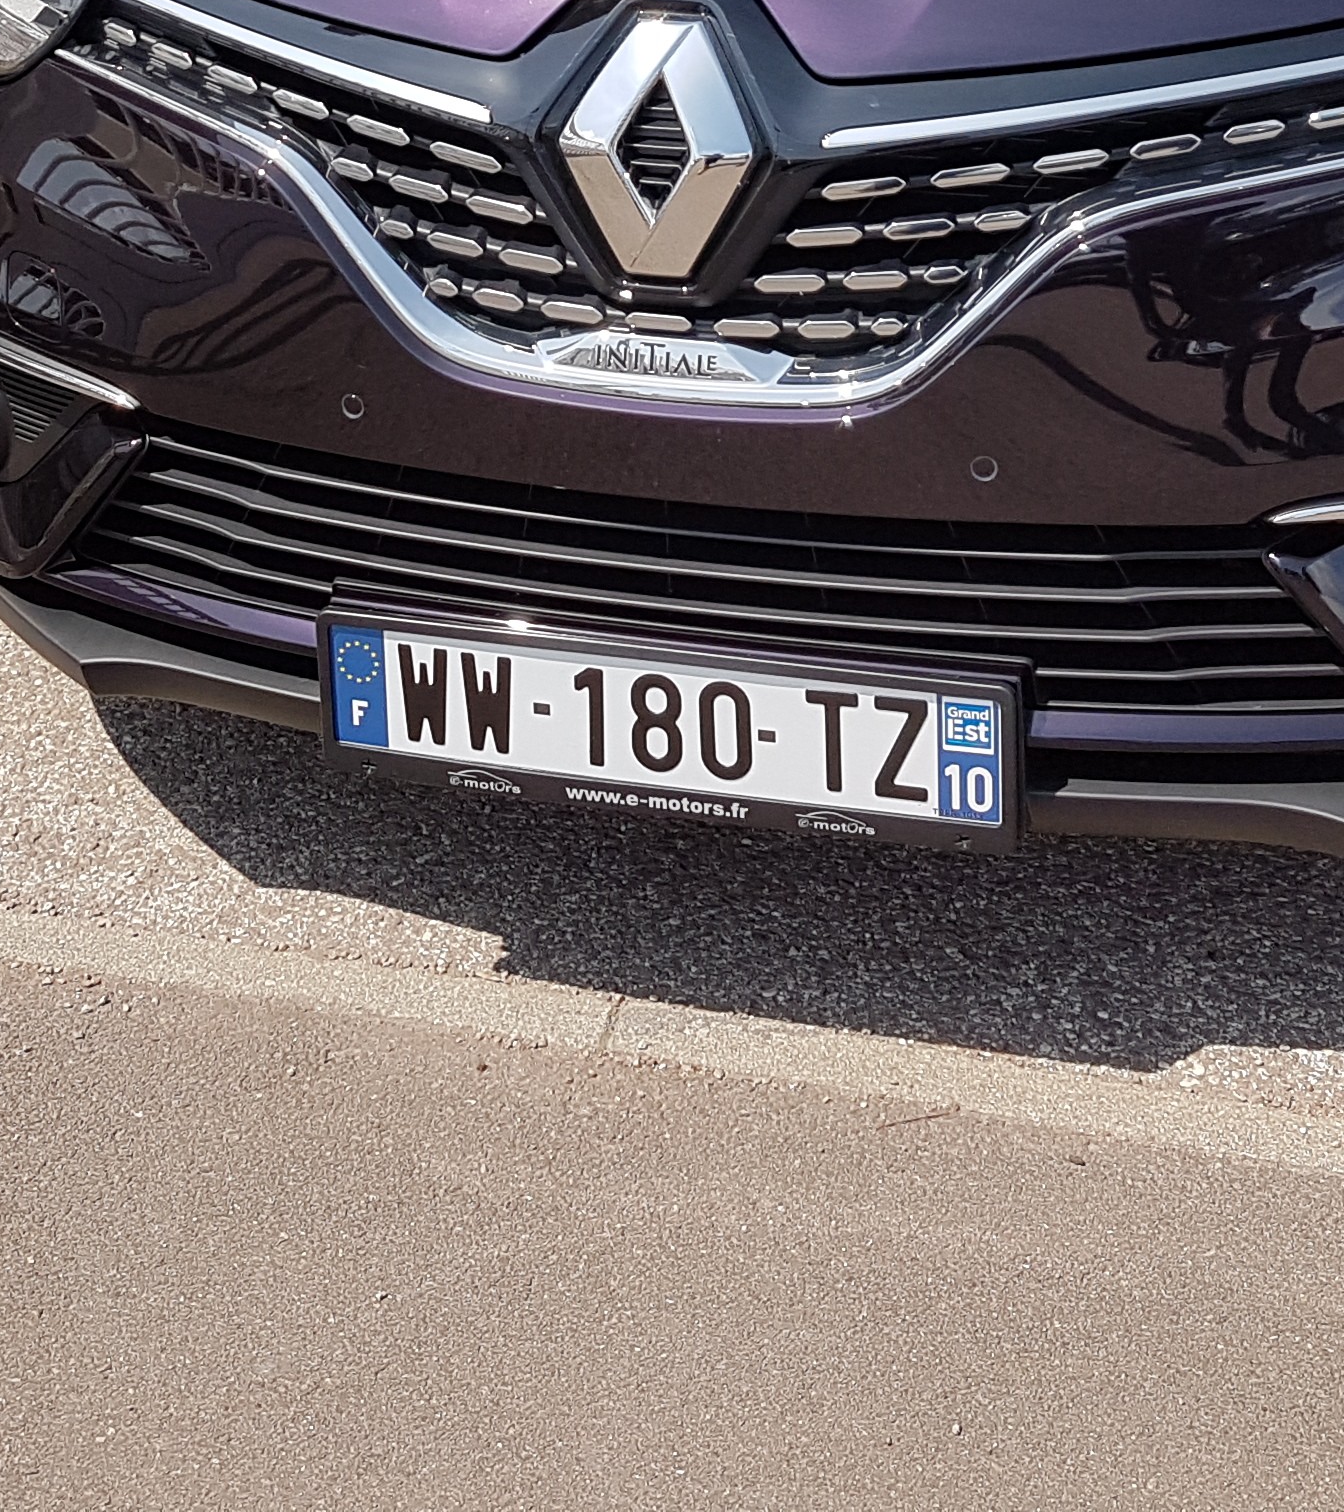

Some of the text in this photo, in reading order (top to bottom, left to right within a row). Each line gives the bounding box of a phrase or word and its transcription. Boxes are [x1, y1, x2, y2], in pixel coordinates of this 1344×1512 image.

[594, 340, 719, 377] INITIALE
[351, 698, 369, 726] F
[947, 706, 989, 721] Grand
[947, 718, 989, 743] Est
[565, 786, 749, 819] www.e-motors.fr
[944, 763, 994, 813] 10
